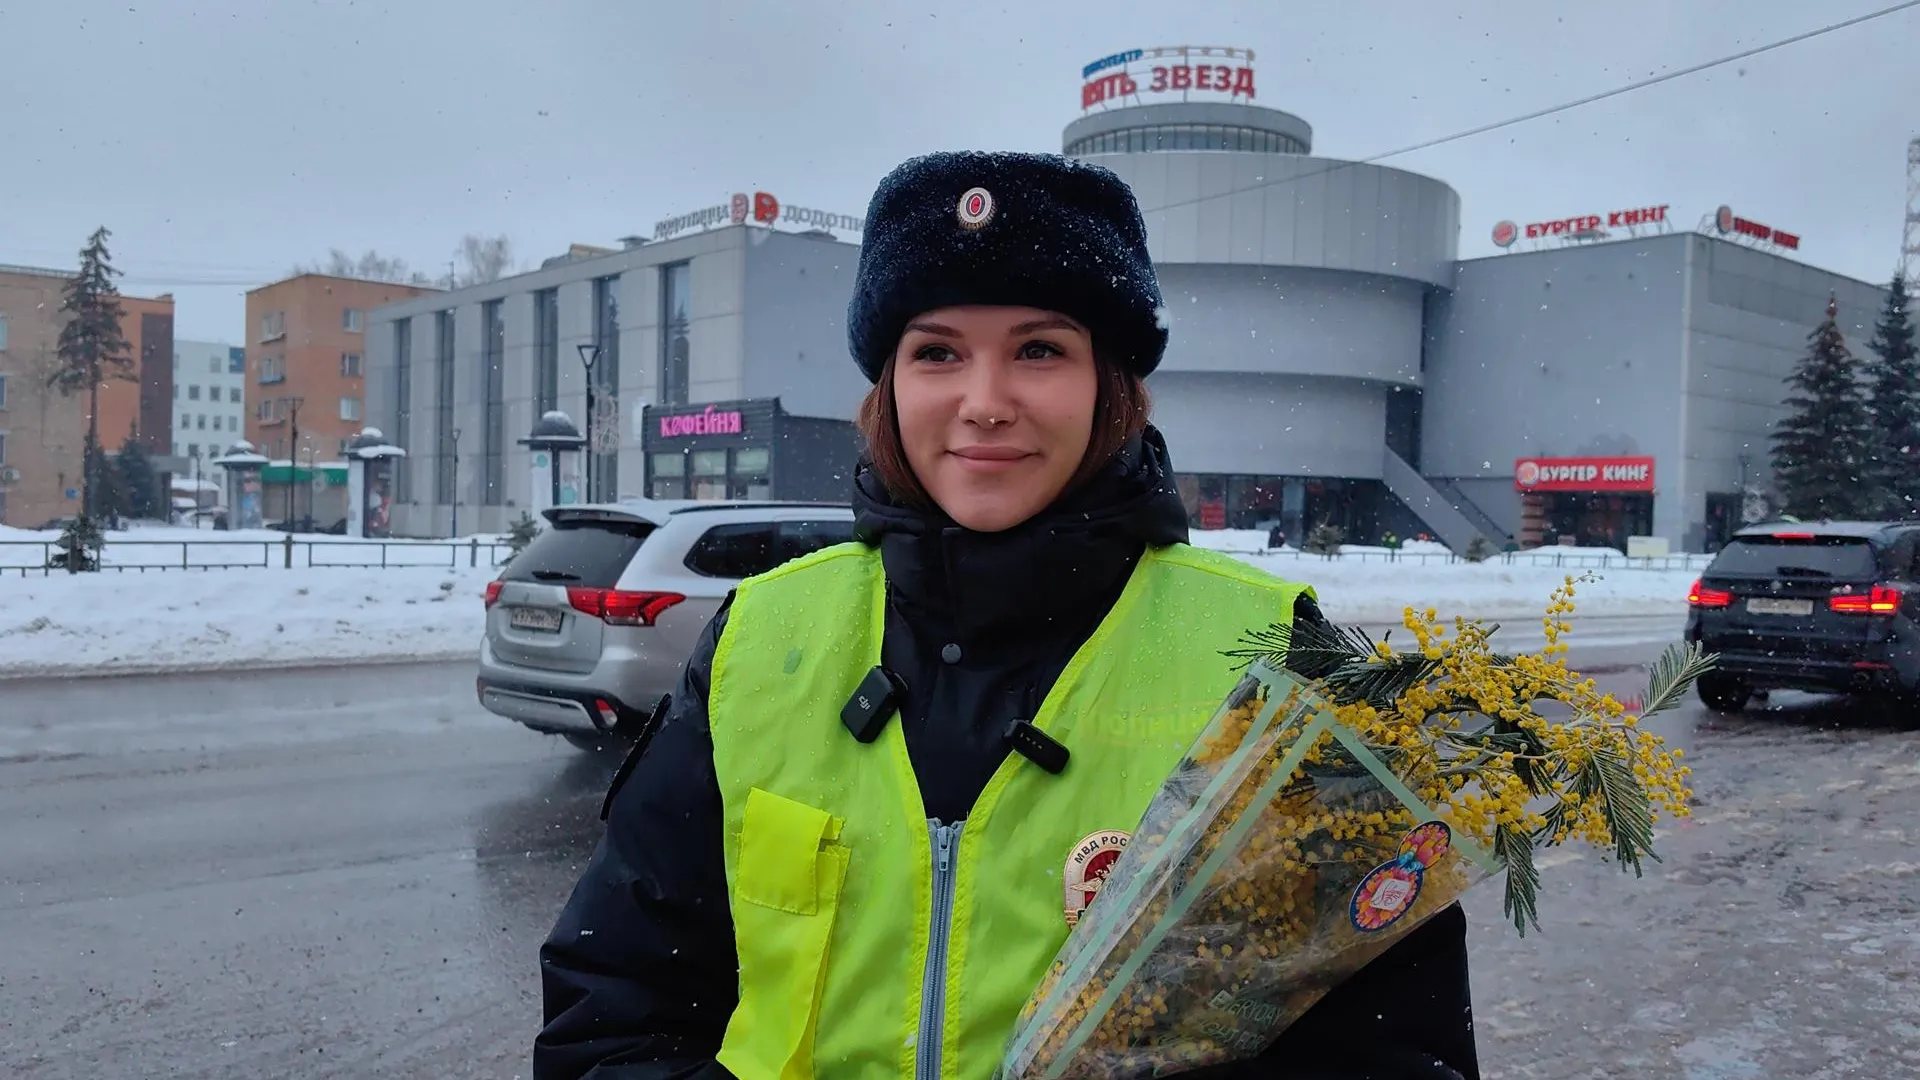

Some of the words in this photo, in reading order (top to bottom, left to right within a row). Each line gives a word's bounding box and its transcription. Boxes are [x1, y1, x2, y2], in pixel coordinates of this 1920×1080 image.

[1151, 64, 1255, 99] ЗВЕЗД
[1526, 215, 1600, 238] БУРГЕР
[1608, 204, 1669, 228] КИНГ
[1540, 465, 1598, 482] БУРГЕР
[1603, 464, 1648, 482] КИНГ
[1074, 840, 1100, 864] МВД
[1101, 836, 1127, 847] РОС
